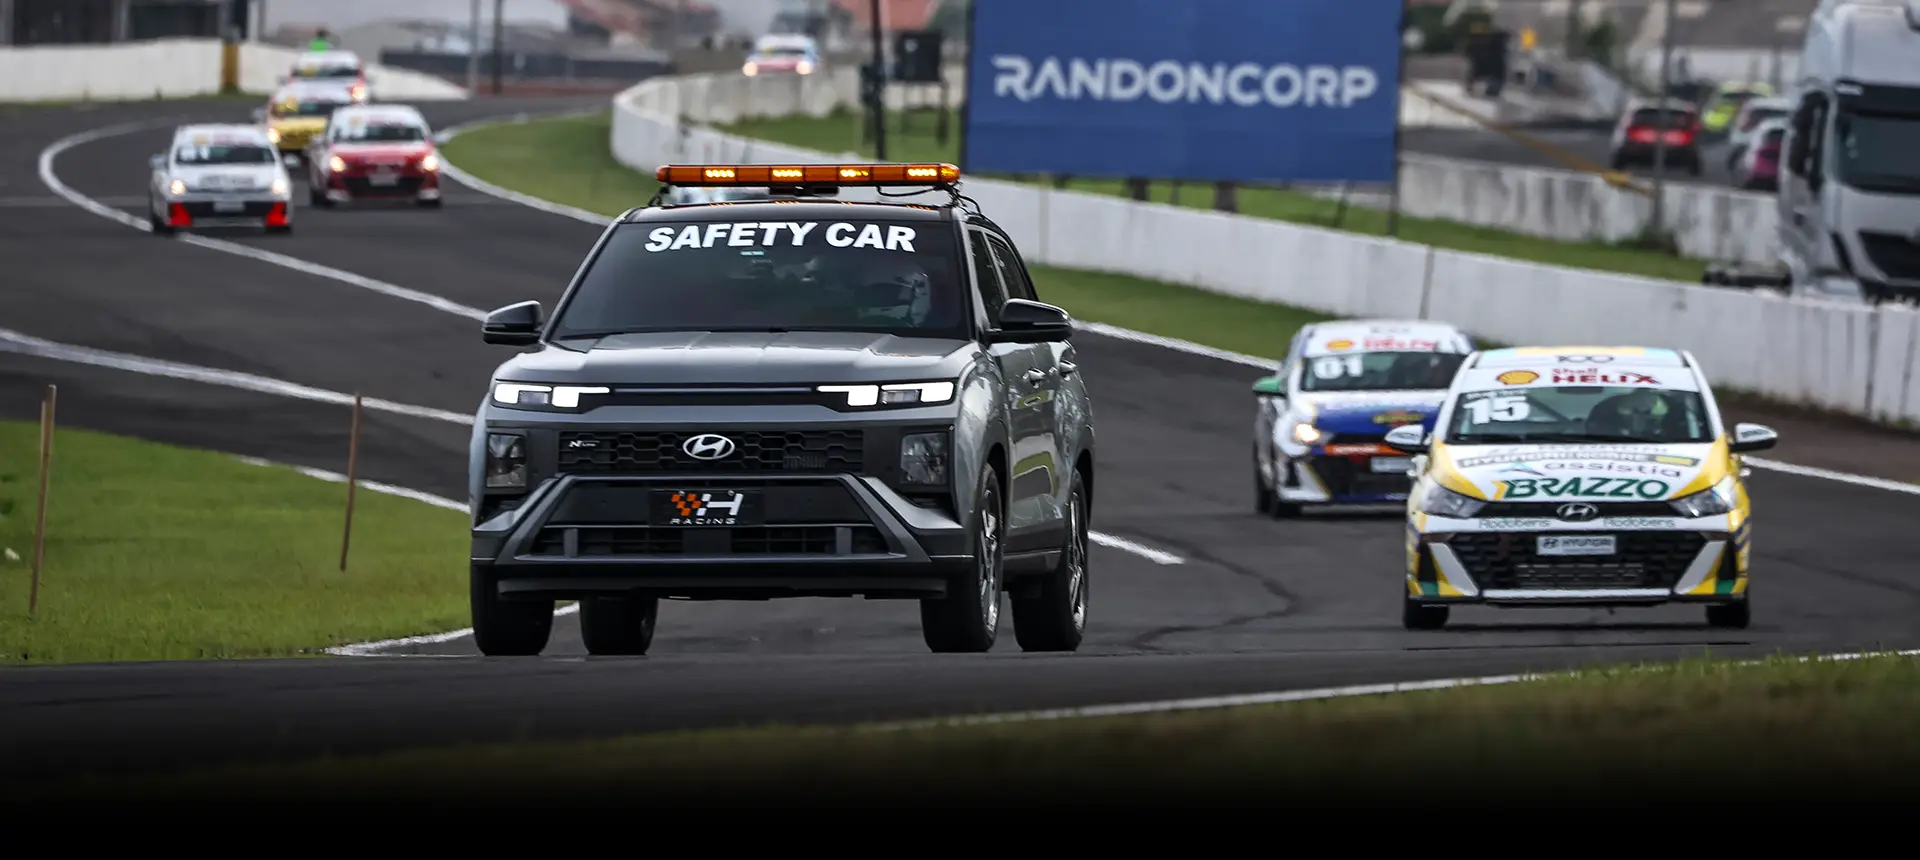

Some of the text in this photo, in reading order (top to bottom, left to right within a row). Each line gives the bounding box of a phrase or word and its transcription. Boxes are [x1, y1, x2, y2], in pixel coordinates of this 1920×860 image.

[991, 55, 1378, 107] RANDONCORP
[645, 222, 916, 252] SAFETY CAR
[1552, 373, 1662, 385] HELIX
[1463, 396, 1531, 424] 15
[1480, 518, 1550, 529] Rodobens
[1604, 518, 1676, 530] Rodobens
